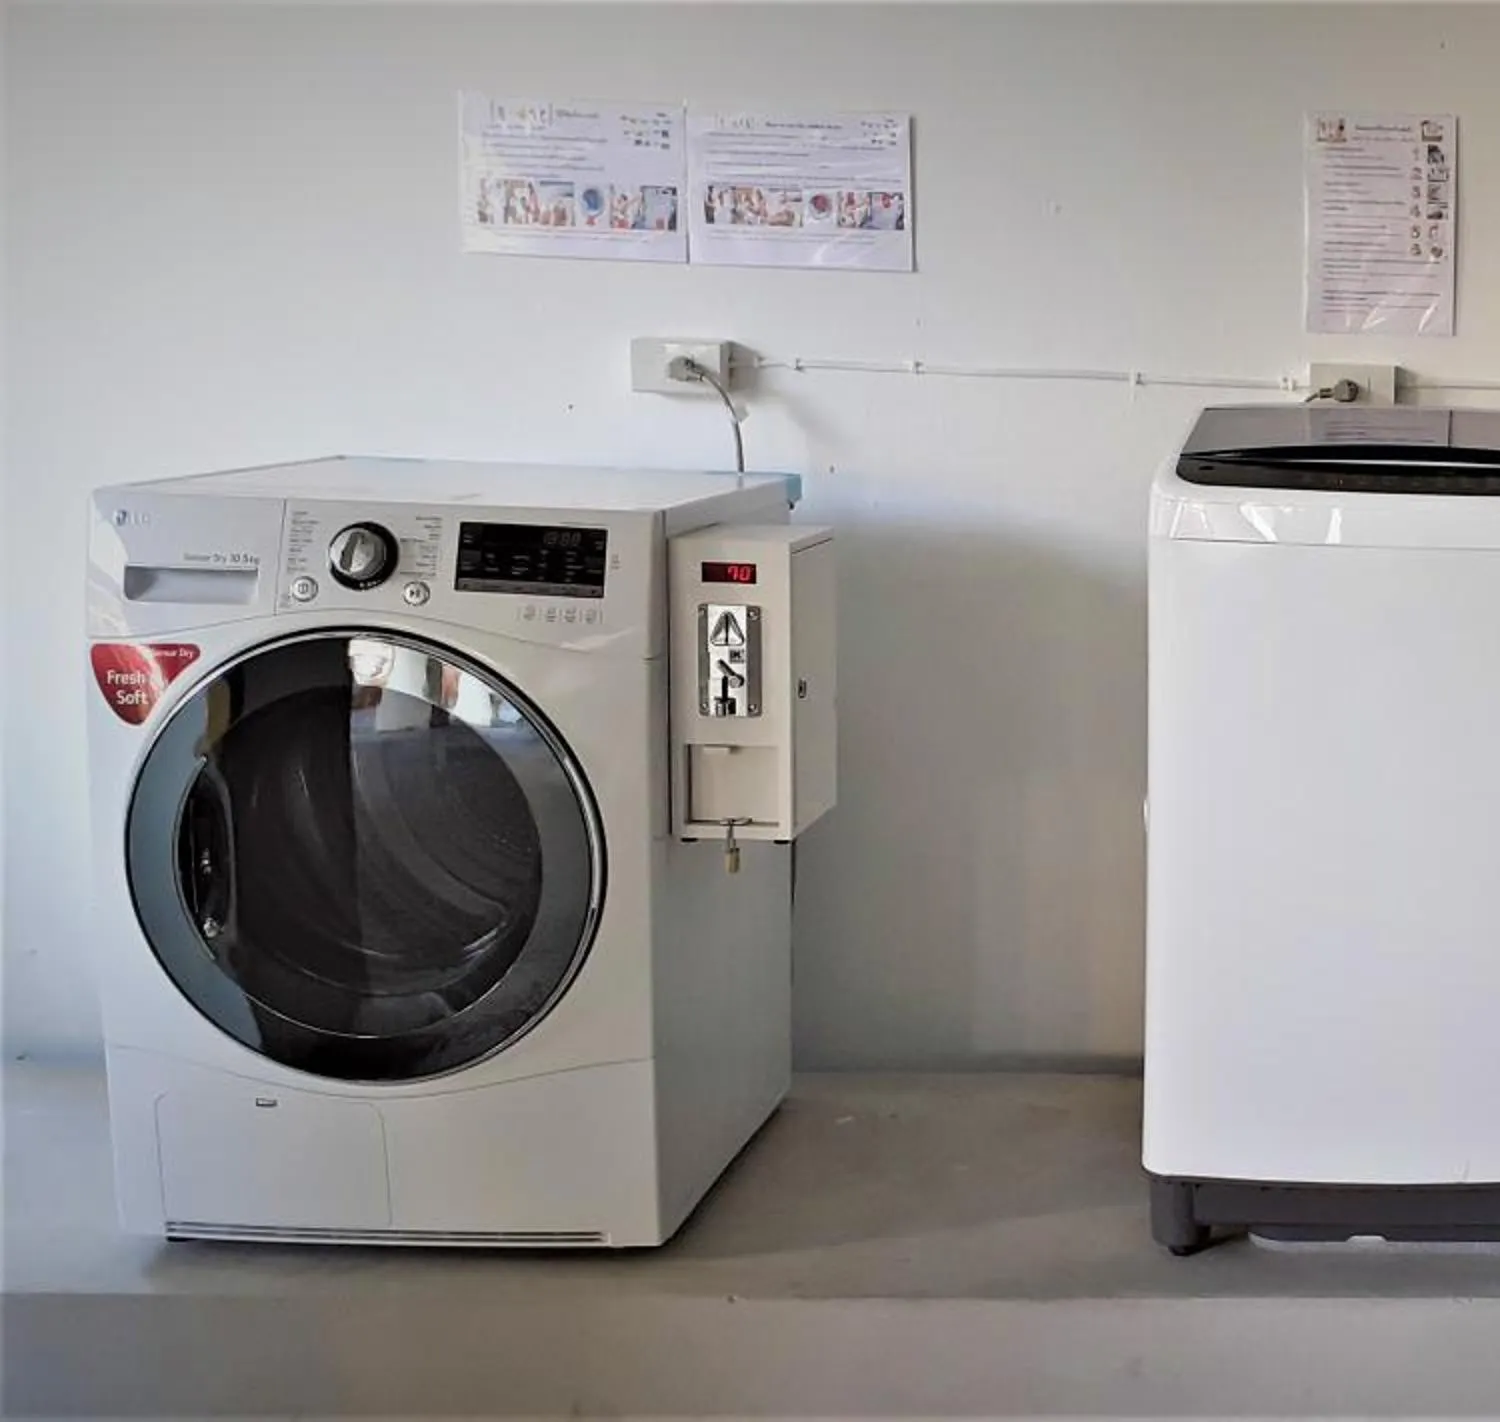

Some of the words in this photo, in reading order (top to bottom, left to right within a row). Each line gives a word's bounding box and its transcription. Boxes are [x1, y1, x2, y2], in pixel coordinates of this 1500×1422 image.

[178, 646, 194, 660] Dry
[106, 669, 145, 685] Fresh
[116, 690, 149, 705] Soft
